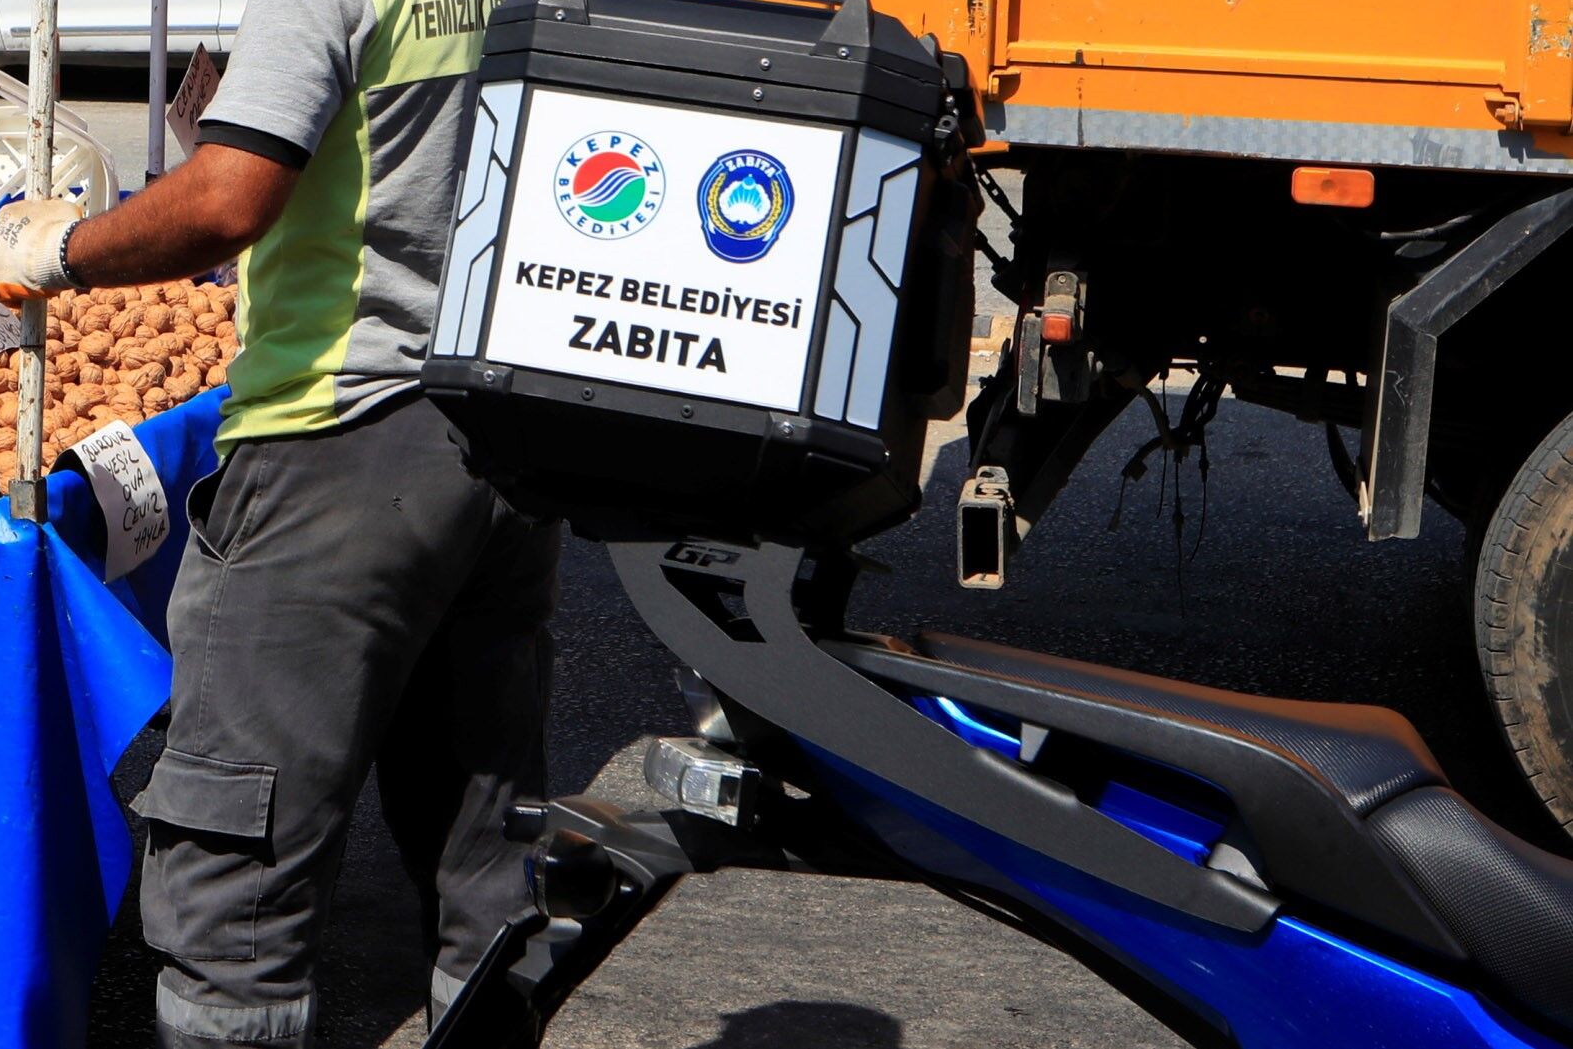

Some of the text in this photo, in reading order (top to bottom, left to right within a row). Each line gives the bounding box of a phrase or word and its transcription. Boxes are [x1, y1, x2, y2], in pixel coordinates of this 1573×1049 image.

[565, 135, 660, 177] KEPEZ
[724, 155, 777, 178] ZABITA
[515, 261, 804, 329] KEPEZ BELEDİYESİ
[567, 314, 728, 374] ZABITA
[664, 541, 741, 568] GP
